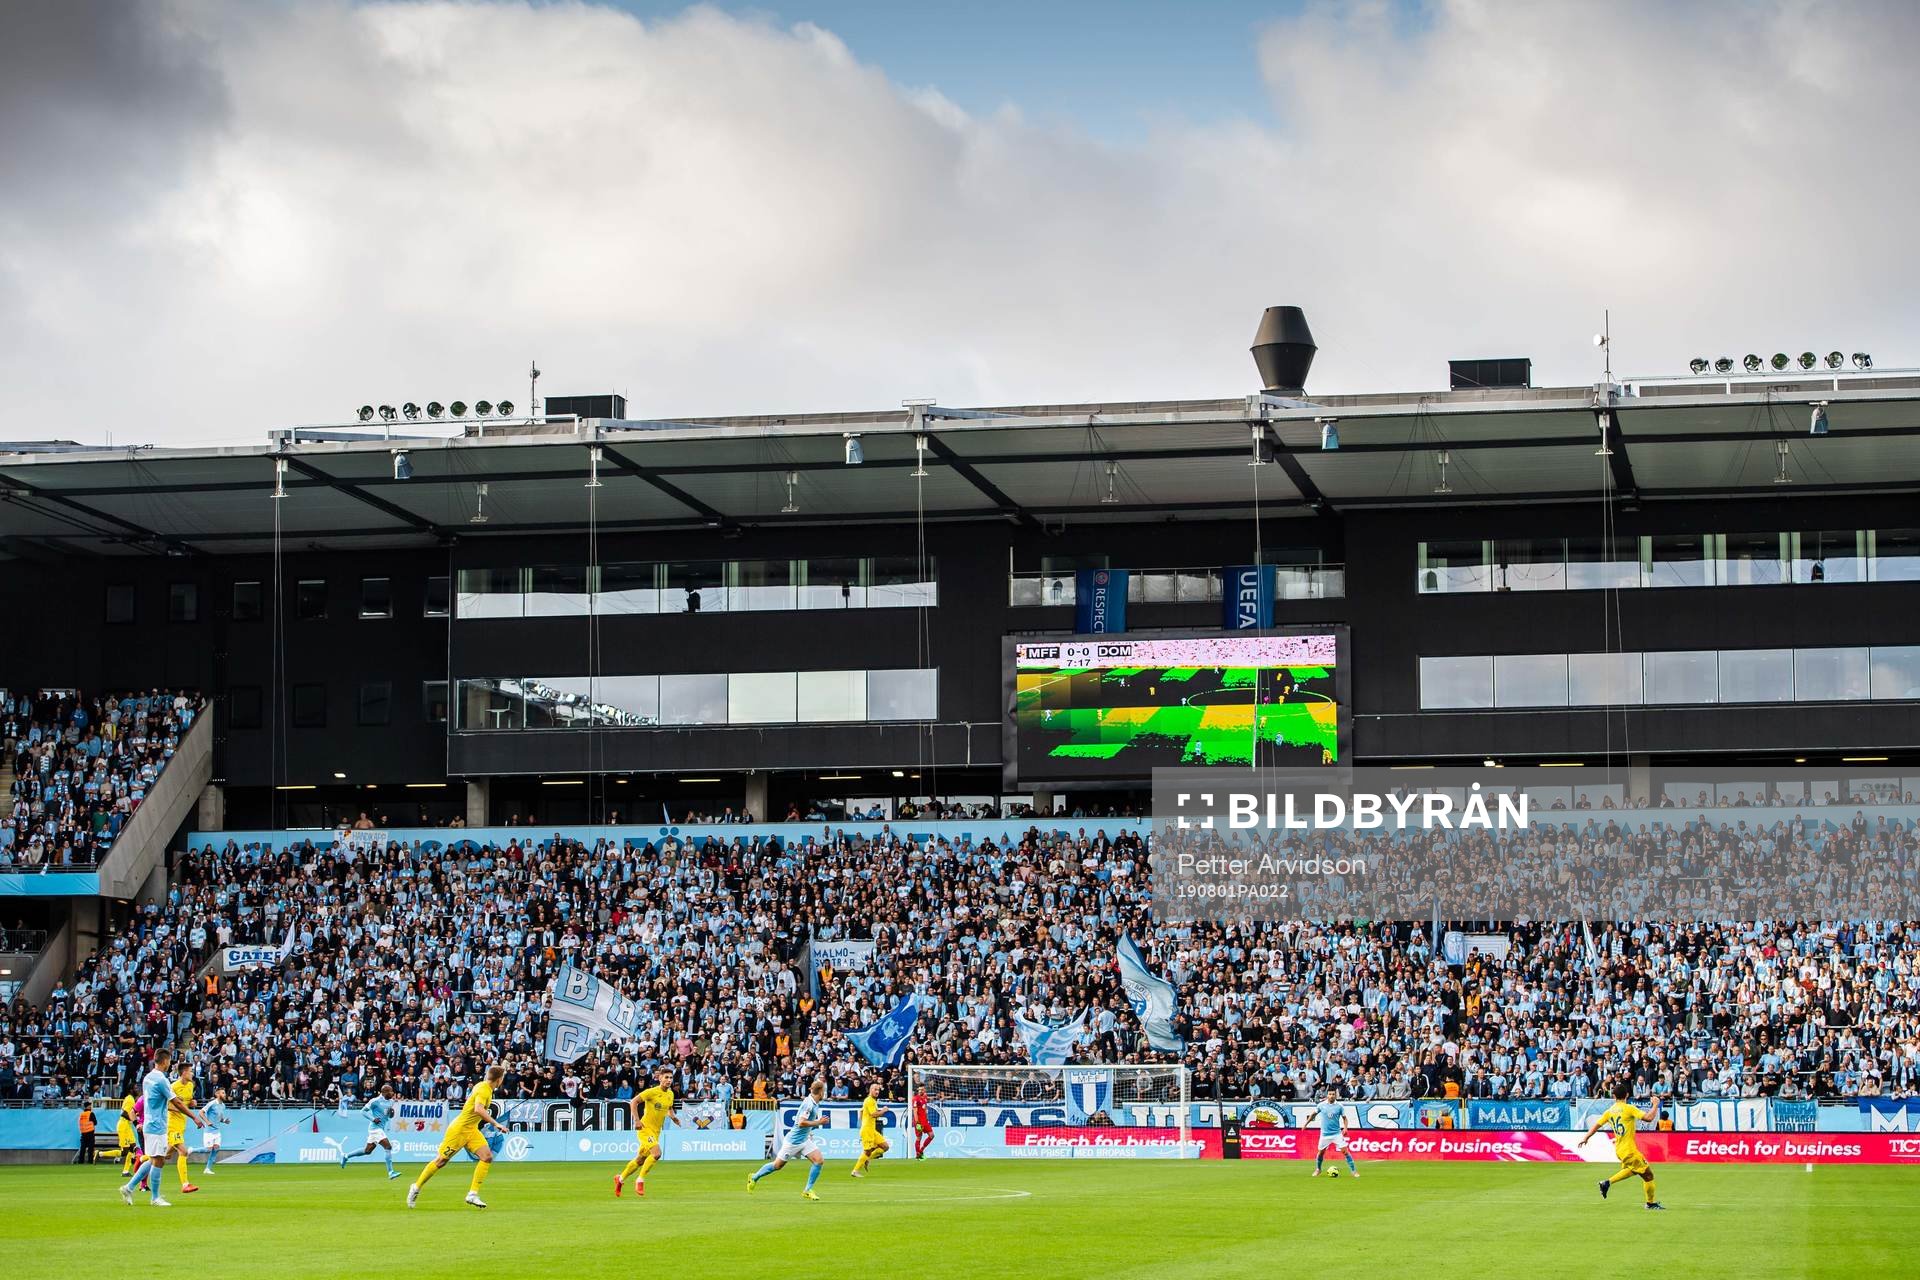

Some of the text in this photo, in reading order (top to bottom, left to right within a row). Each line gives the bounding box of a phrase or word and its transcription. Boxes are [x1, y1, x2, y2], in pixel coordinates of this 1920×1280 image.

[1239, 571, 1257, 629] UEFA
[1094, 588, 1106, 634] RESPECT
[1028, 646, 1131, 658] MFF 0-0 DOM
[1067, 659, 1091, 667] 7:17
[400, 1103, 443, 1119] MALMÖ
[1675, 1099, 1768, 1131] 1910
[1610, 1116, 1625, 1136] 16
[692, 1141, 747, 1153] Tillmobil
[1025, 1134, 1091, 1146] Edtech
[1094, 1134, 1123, 1146] for
[1408, 1138, 1436, 1153] for
[1440, 1138, 1523, 1153] business
[299, 1148, 337, 1161] PUMA
[443, 1146, 456, 1157] 27
[1011, 1148, 1039, 1158] HALVA
[1040, 1148, 1071, 1158] PRISET
[1074, 1148, 1093, 1158] MED
[1686, 1139, 1861, 1156] Edtech for business
